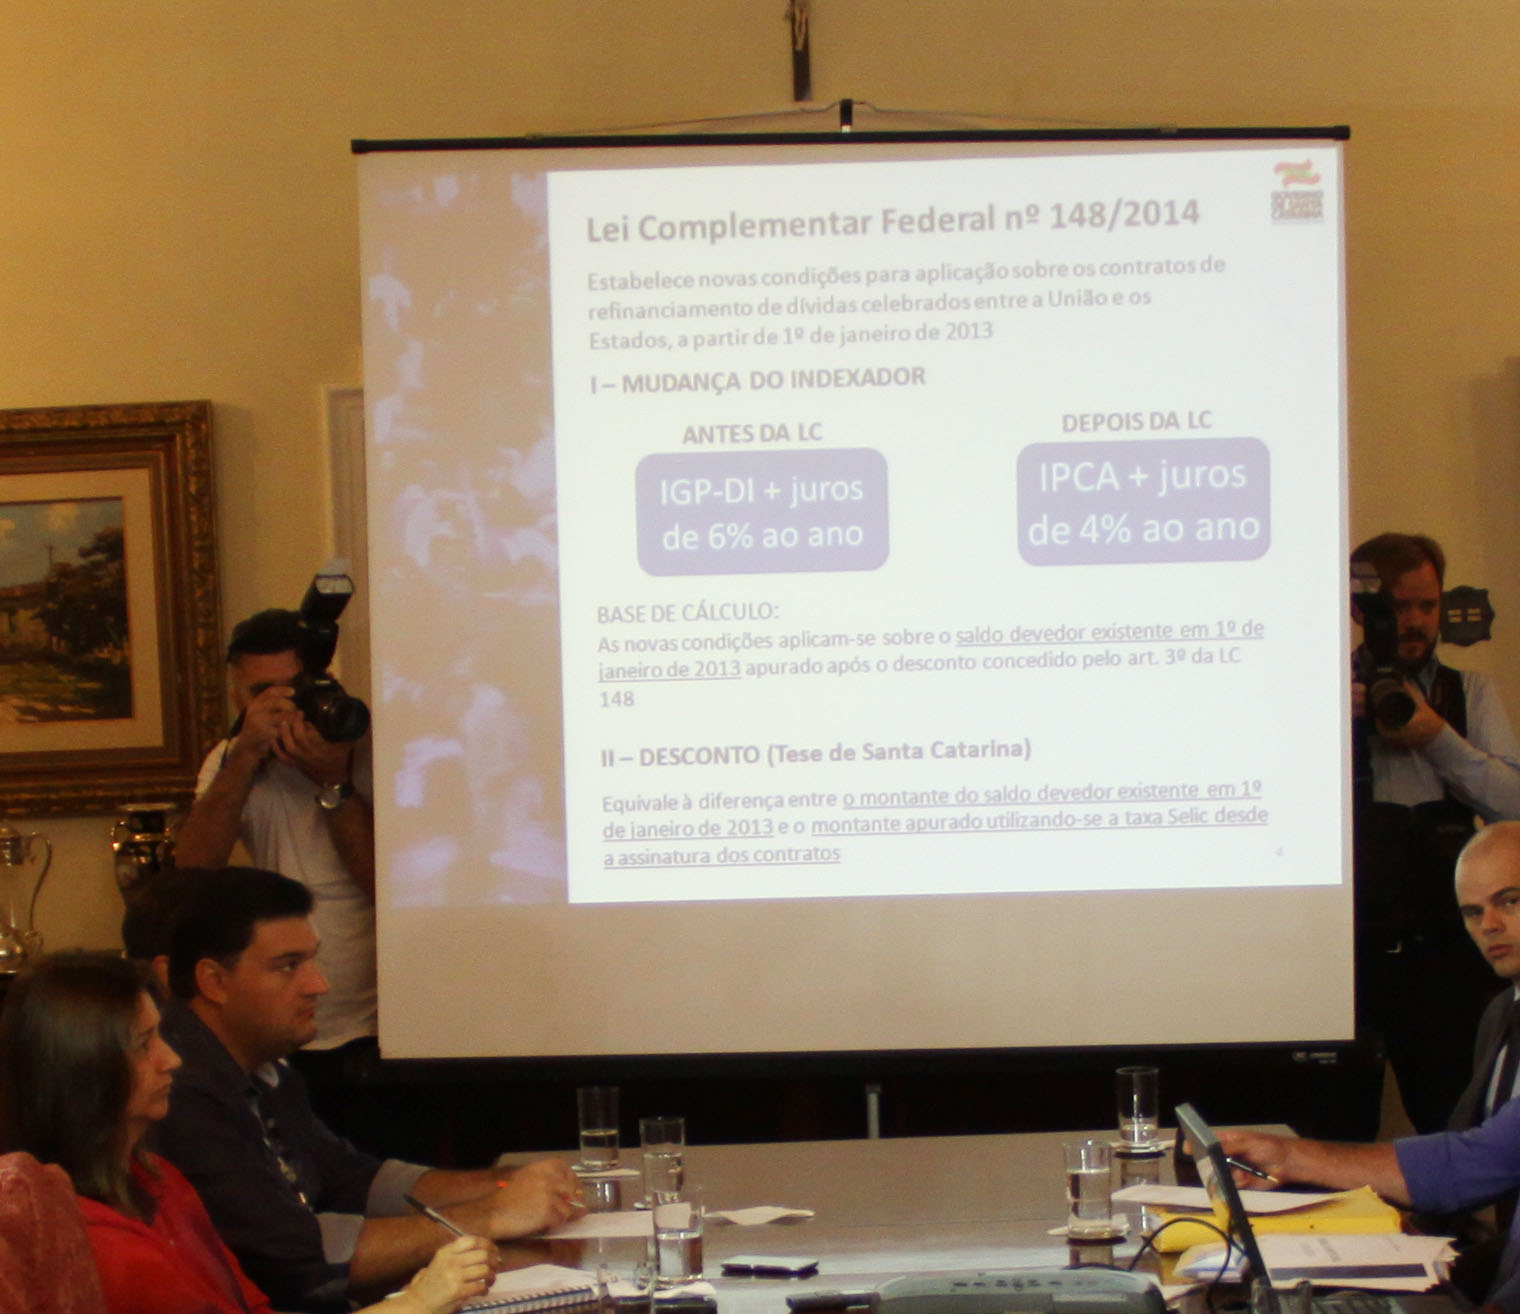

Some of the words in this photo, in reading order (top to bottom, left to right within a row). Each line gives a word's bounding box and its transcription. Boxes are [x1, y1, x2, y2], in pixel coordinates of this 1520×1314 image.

[586, 215, 630, 243] Lei
[637, 212, 873, 243] Complementar
[881, 204, 995, 234] Federal
[1050, 198, 1201, 231] 148/2014
[586, 271, 695, 291] Estabelece
[697, 273, 759, 288] novas
[759, 266, 863, 289] condições
[864, 268, 912, 288] para
[914, 261, 1010, 285] aplicação
[1011, 260, 1069, 279] sobre
[1071, 262, 1097, 277] os
[1098, 259, 1197, 277] contratos
[1199, 253, 1226, 273] de
[587, 301, 754, 320] refinanciamento
[756, 296, 783, 316] de
[785, 294, 858, 315] dívidas
[860, 292, 972, 313] celebrados
[973, 293, 1029, 310] entre
[1031, 294, 1044, 308] a
[1047, 288, 1109, 307] União
[1110, 291, 1125, 306] e
[1127, 290, 1152, 305] os
[588, 331, 673, 351] Estados,
[676, 333, 689, 348] a
[692, 328, 750, 352] partir
[751, 326, 779, 345] de
[808, 324, 836, 344] de
[839, 324, 912, 348] janeiro
[914, 322, 941, 341] de
[945, 320, 994, 341] 2013
[589, 375, 597, 395] I
[621, 371, 742, 395] MUDANÇA
[749, 370, 784, 390] DO
[790, 366, 926, 388] INDEXADOR
[681, 423, 755, 445] ANTES
[758, 422, 791, 443] DA
[797, 421, 823, 442] LC
[1061, 411, 1145, 433] DEPOIS
[1148, 410, 1181, 431] DA
[1187, 409, 1212, 430] LC
[660, 477, 755, 505] IGP-DI
[763, 480, 782, 500] +
[788, 476, 864, 508] juros
[1040, 461, 1121, 492] IPCA
[1127, 465, 1149, 487] +
[1156, 459, 1247, 496] juros
[661, 522, 699, 551] de
[707, 522, 754, 550] 6%
[761, 527, 799, 549] ao
[807, 525, 864, 547] ano
[1027, 513, 1072, 546] de
[1078, 512, 1132, 544] 4%
[1142, 518, 1185, 543] ao
[1195, 516, 1261, 541] ano
[596, 604, 647, 624] BASE
[650, 603, 676, 623] DE
[680, 599, 780, 622] CÁLCULO:
[596, 636, 621, 654] As
[623, 637, 679, 653] novas
[680, 631, 774, 653] condições
[777, 630, 877, 651] aplicam-se
[881, 627, 935, 646] sobre
[938, 630, 952, 645] o
[955, 625, 1004, 646] saldo
[1008, 624, 1087, 646] devedor
[1090, 622, 1174, 645] existente
[1179, 623, 1209, 644] em
[1240, 618, 1265, 641] de
[598, 661, 664, 684] janeiro
[665, 660, 691, 682] de
[693, 659, 742, 681] 2013
[744, 657, 824, 679] apurado
[825, 655, 872, 677] após
[874, 658, 889, 673] o
[891, 655, 977, 672] desconto
[981, 650, 1078, 670] concedido
[1081, 649, 1123, 670] pelo
[1127, 650, 1160, 666] art.
[1190, 646, 1214, 664] da
[1218, 645, 1241, 664] LC
[600, 690, 635, 708] 148
[600, 748, 615, 767] II
[638, 745, 761, 767] DESCONTO
[766, 743, 823, 768] (Tese
[828, 742, 857, 762] de
[861, 742, 924, 761] Santa
[929, 738, 1032, 761] Catarina)
[601, 794, 679, 815] Equivale
[681, 792, 693, 811] à
[697, 791, 785, 811] diferença
[787, 792, 838, 808] entre
[841, 792, 856, 811] o
[859, 790, 950, 810] montante
[953, 786, 980, 808] do
[982, 784, 1032, 807] saldo
[1036, 783, 1114, 806] devedor
[1116, 782, 1199, 804] existente
[1206, 783, 1236, 802] em
[601, 821, 627, 843] de
[629, 820, 696, 842] janeiro
[697, 818, 722, 841] de
[726, 817, 775, 840] 2013
[777, 820, 790, 835] e
[791, 820, 806, 835] o
[810, 817, 903, 837] montante
[904, 813, 986, 835] apurado
[985, 810, 1103, 833] utilizando-se
[1107, 812, 1120, 830] a
[1124, 811, 1164, 830] taxa
[1167, 806, 1209, 829] Selic
[1213, 805, 1270, 828] desde
[602, 852, 616, 871] a
[616, 849, 712, 870] assinatura
[715, 845, 750, 868] dos
[752, 847, 841, 867] contratos
